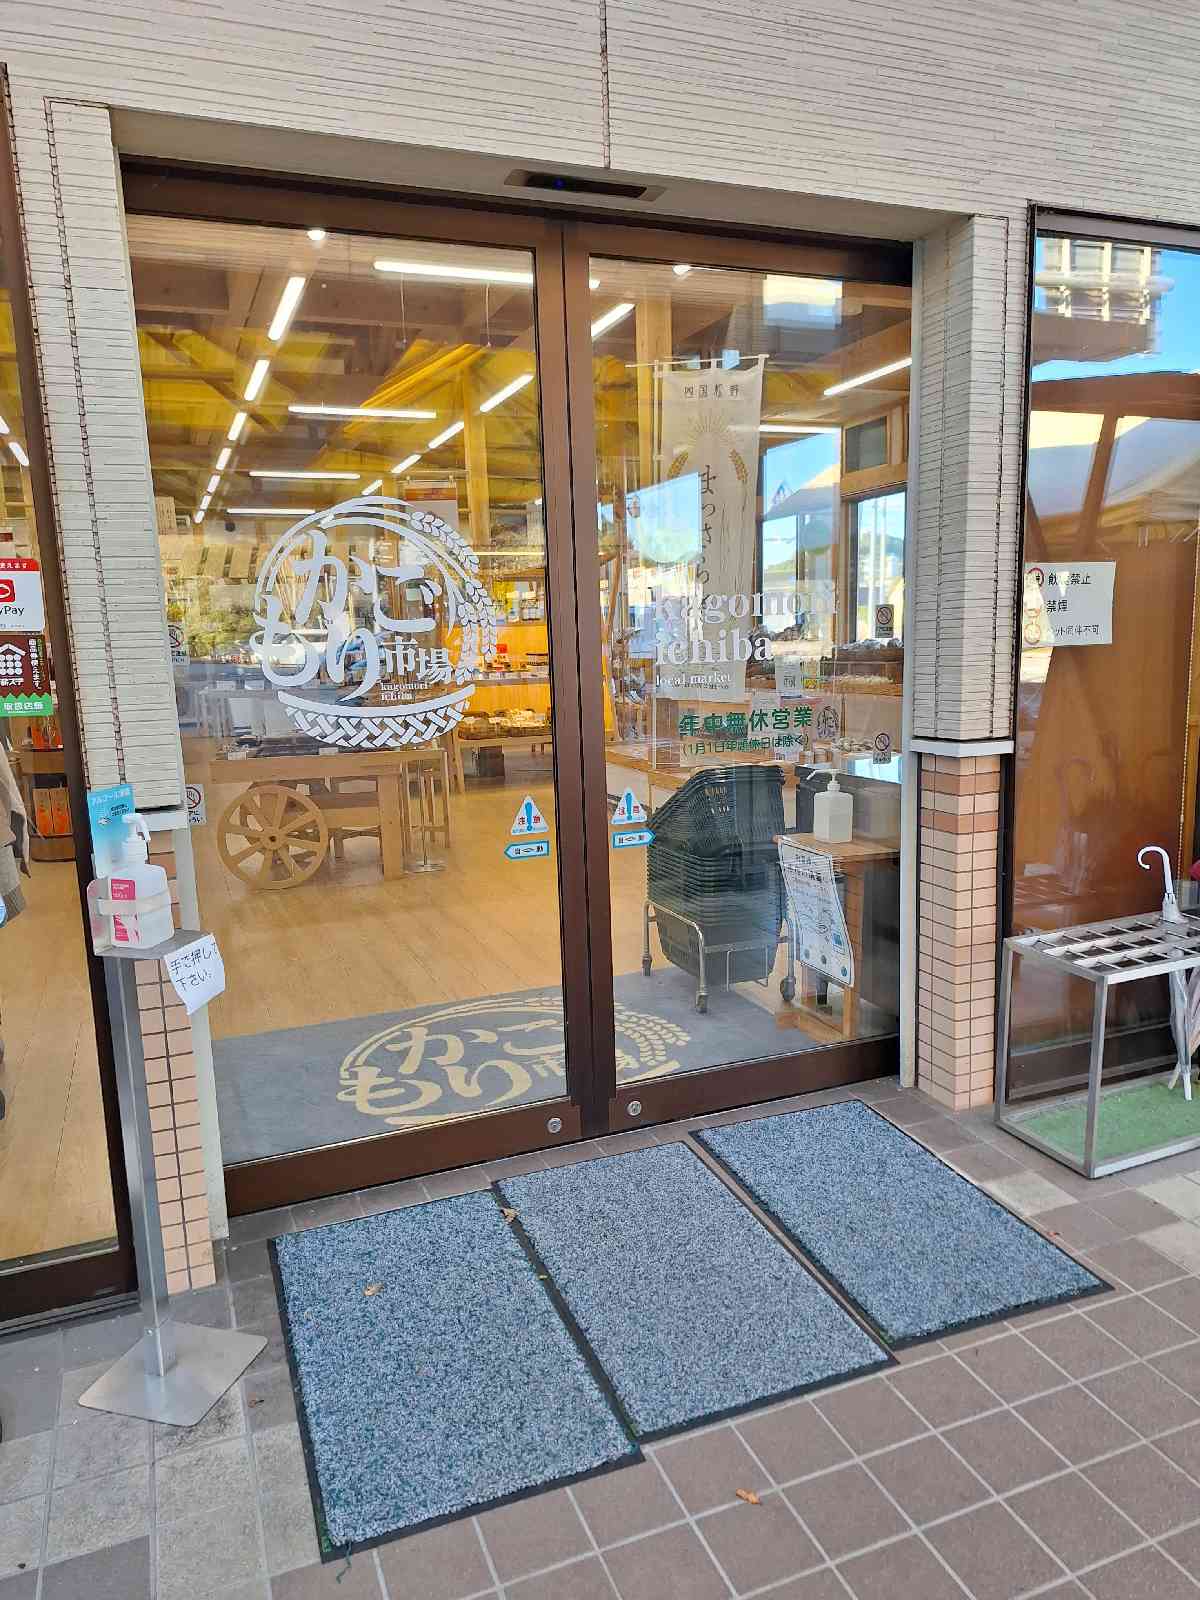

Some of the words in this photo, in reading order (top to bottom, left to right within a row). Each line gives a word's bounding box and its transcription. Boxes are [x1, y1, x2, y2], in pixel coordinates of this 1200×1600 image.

[1046, 600, 1068, 613] 禁煙
[656, 628, 774, 665] ichiba
[679, 704, 813, 736] 年中無休営業
